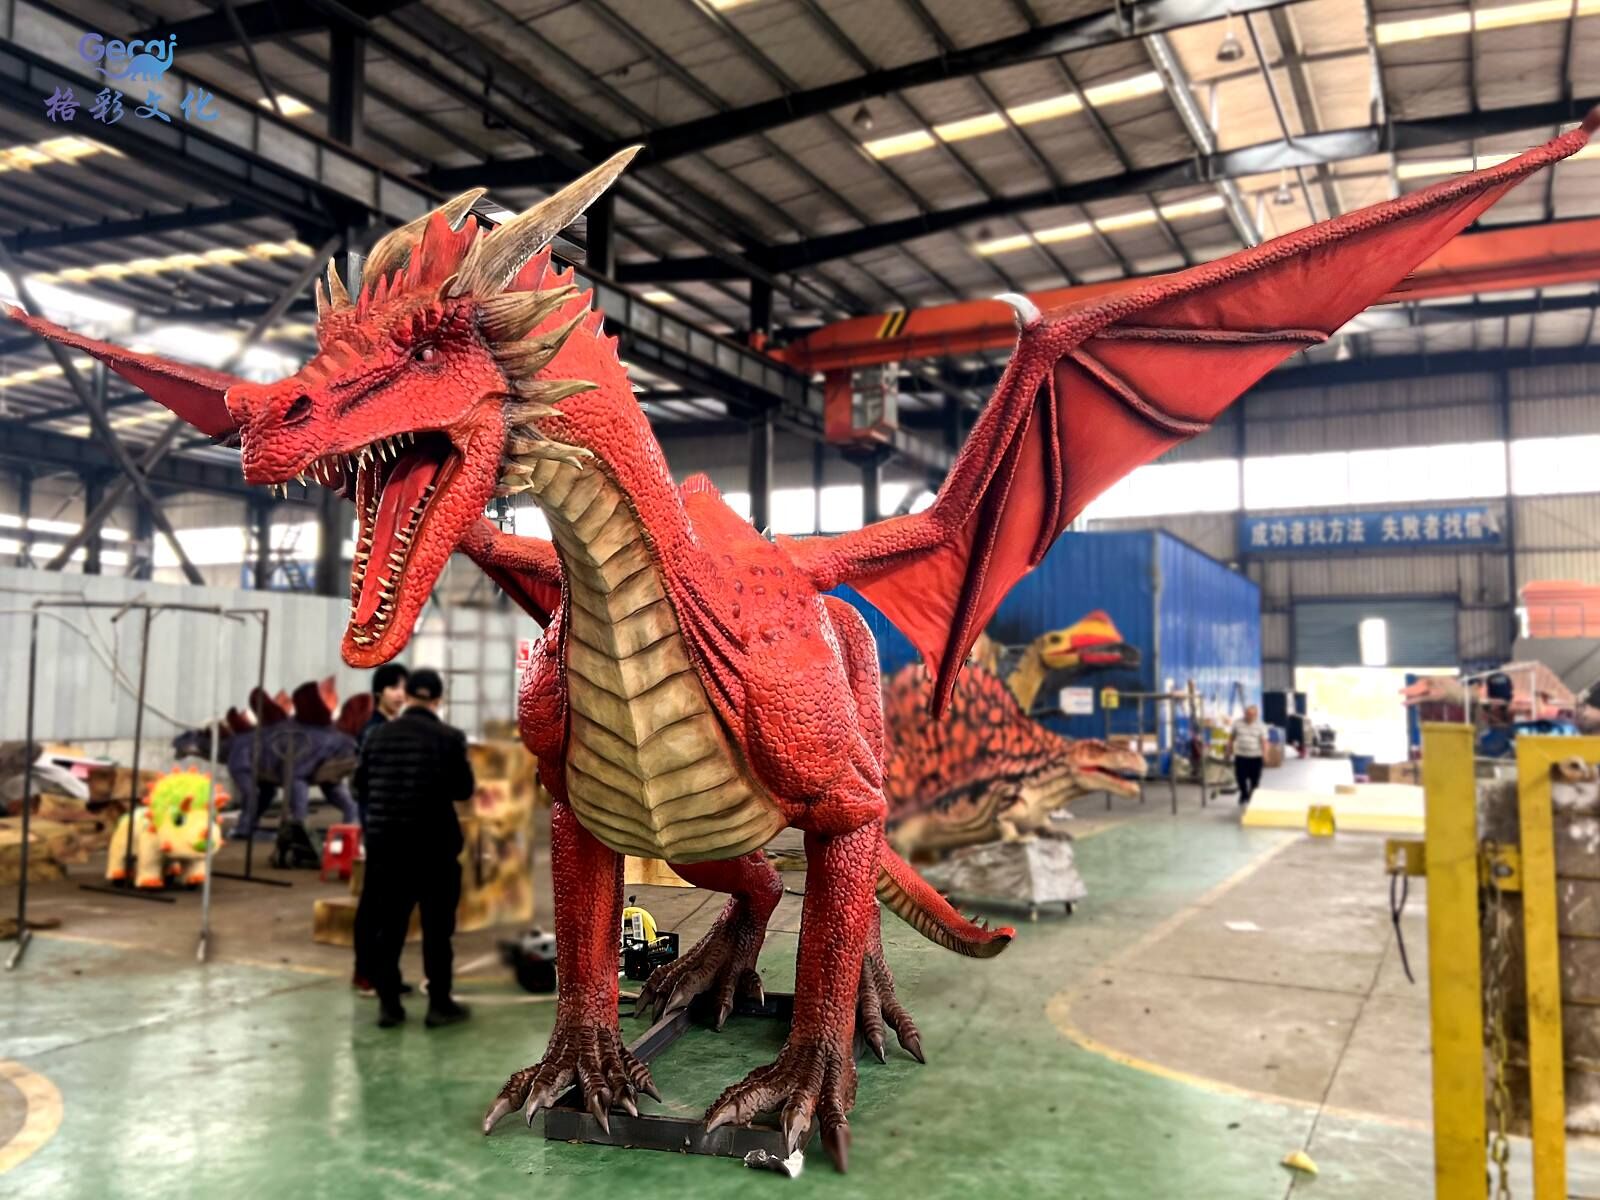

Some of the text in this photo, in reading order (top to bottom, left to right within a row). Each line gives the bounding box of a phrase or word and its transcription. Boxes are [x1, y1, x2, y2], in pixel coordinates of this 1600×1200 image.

[1251, 511, 1500, 546] 成功者找方法 失败者找借
